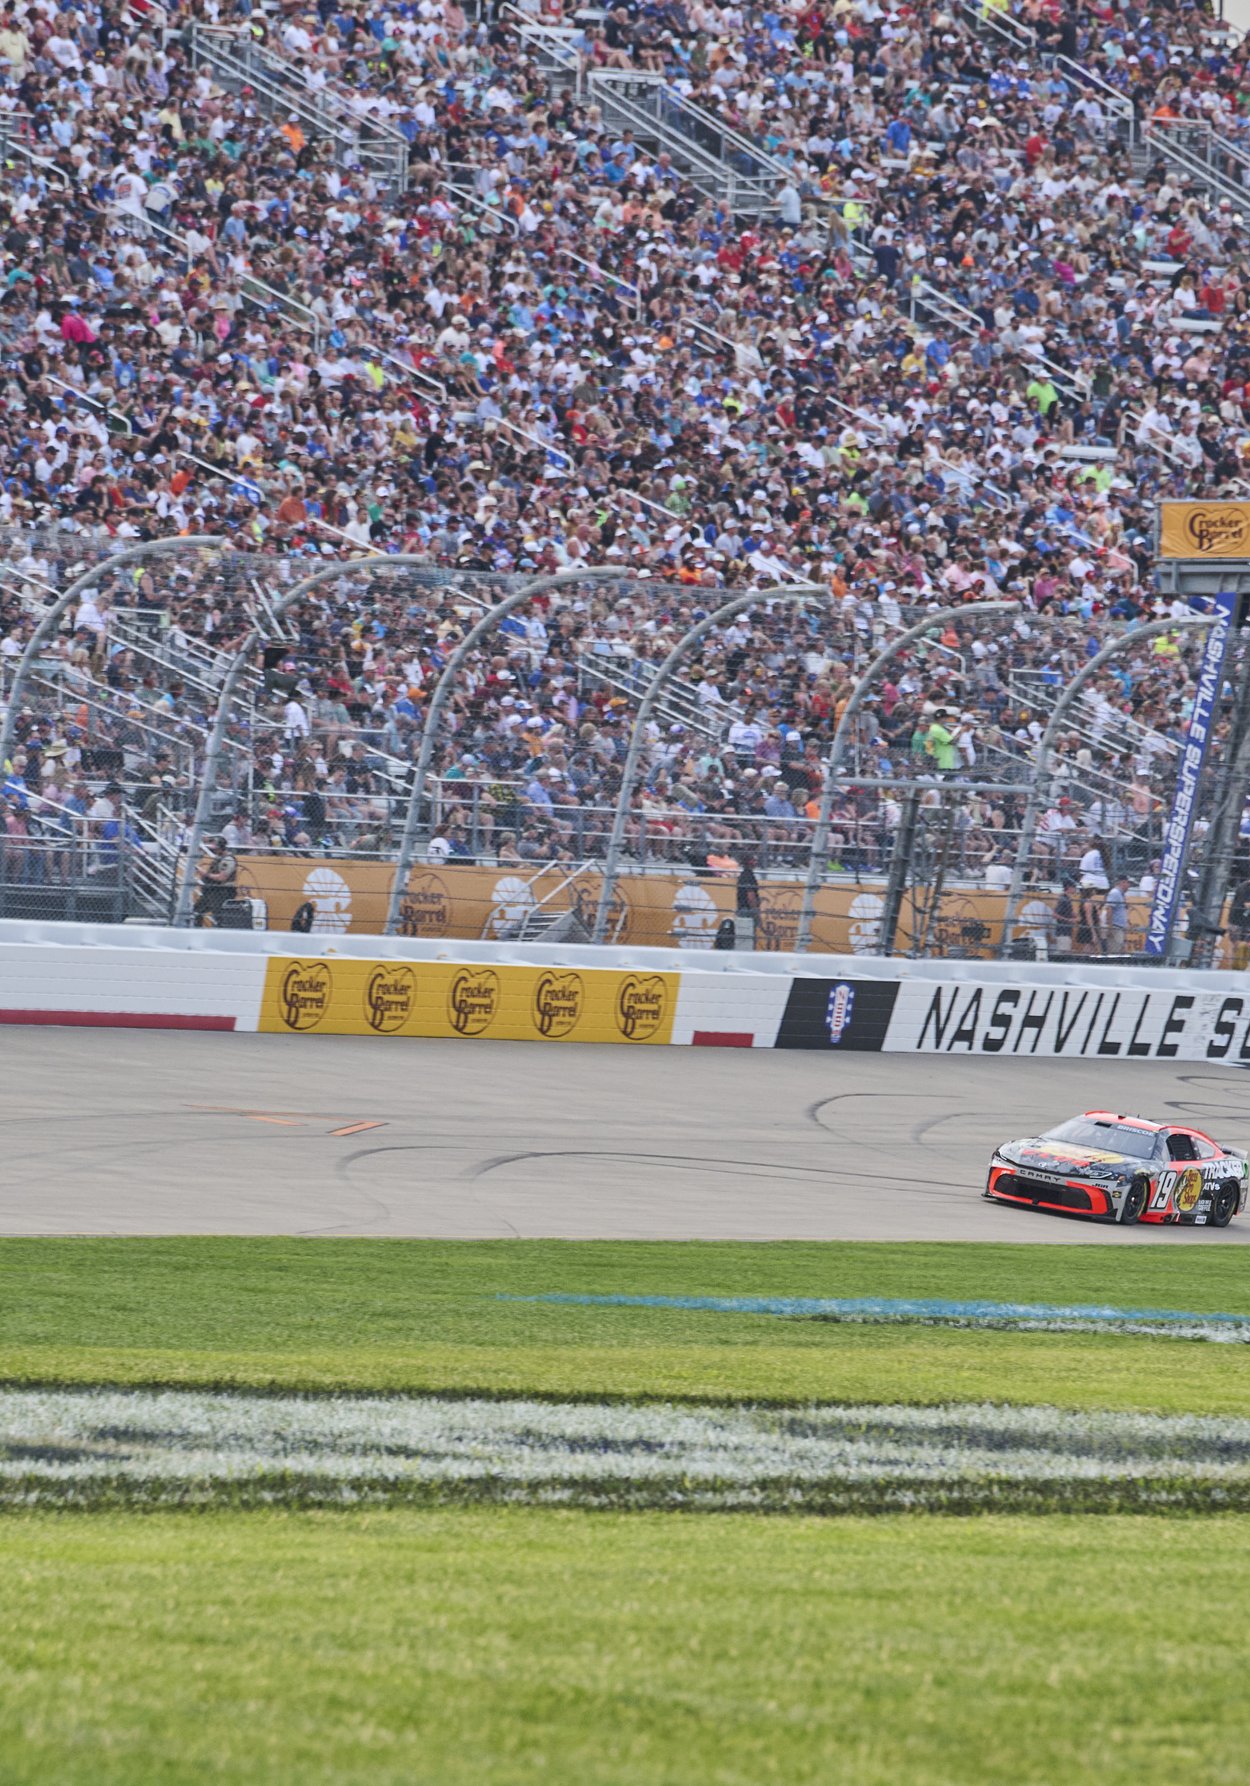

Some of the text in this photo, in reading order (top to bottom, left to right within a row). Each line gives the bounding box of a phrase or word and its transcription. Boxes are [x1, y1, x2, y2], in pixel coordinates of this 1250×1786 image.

[1189, 513, 1242, 538] Cracker
[283, 969, 326, 1006] Cracker
[368, 973, 411, 1009] Cracker
[452, 976, 495, 1013] Cracker
[537, 979, 579, 1015] Cracker
[620, 983, 662, 1019] Cracker
[917, 986, 1196, 1057] NASHVILLE
[1020, 1169, 1061, 1182] CAMRY
[1150, 1170, 1178, 1209] 19
